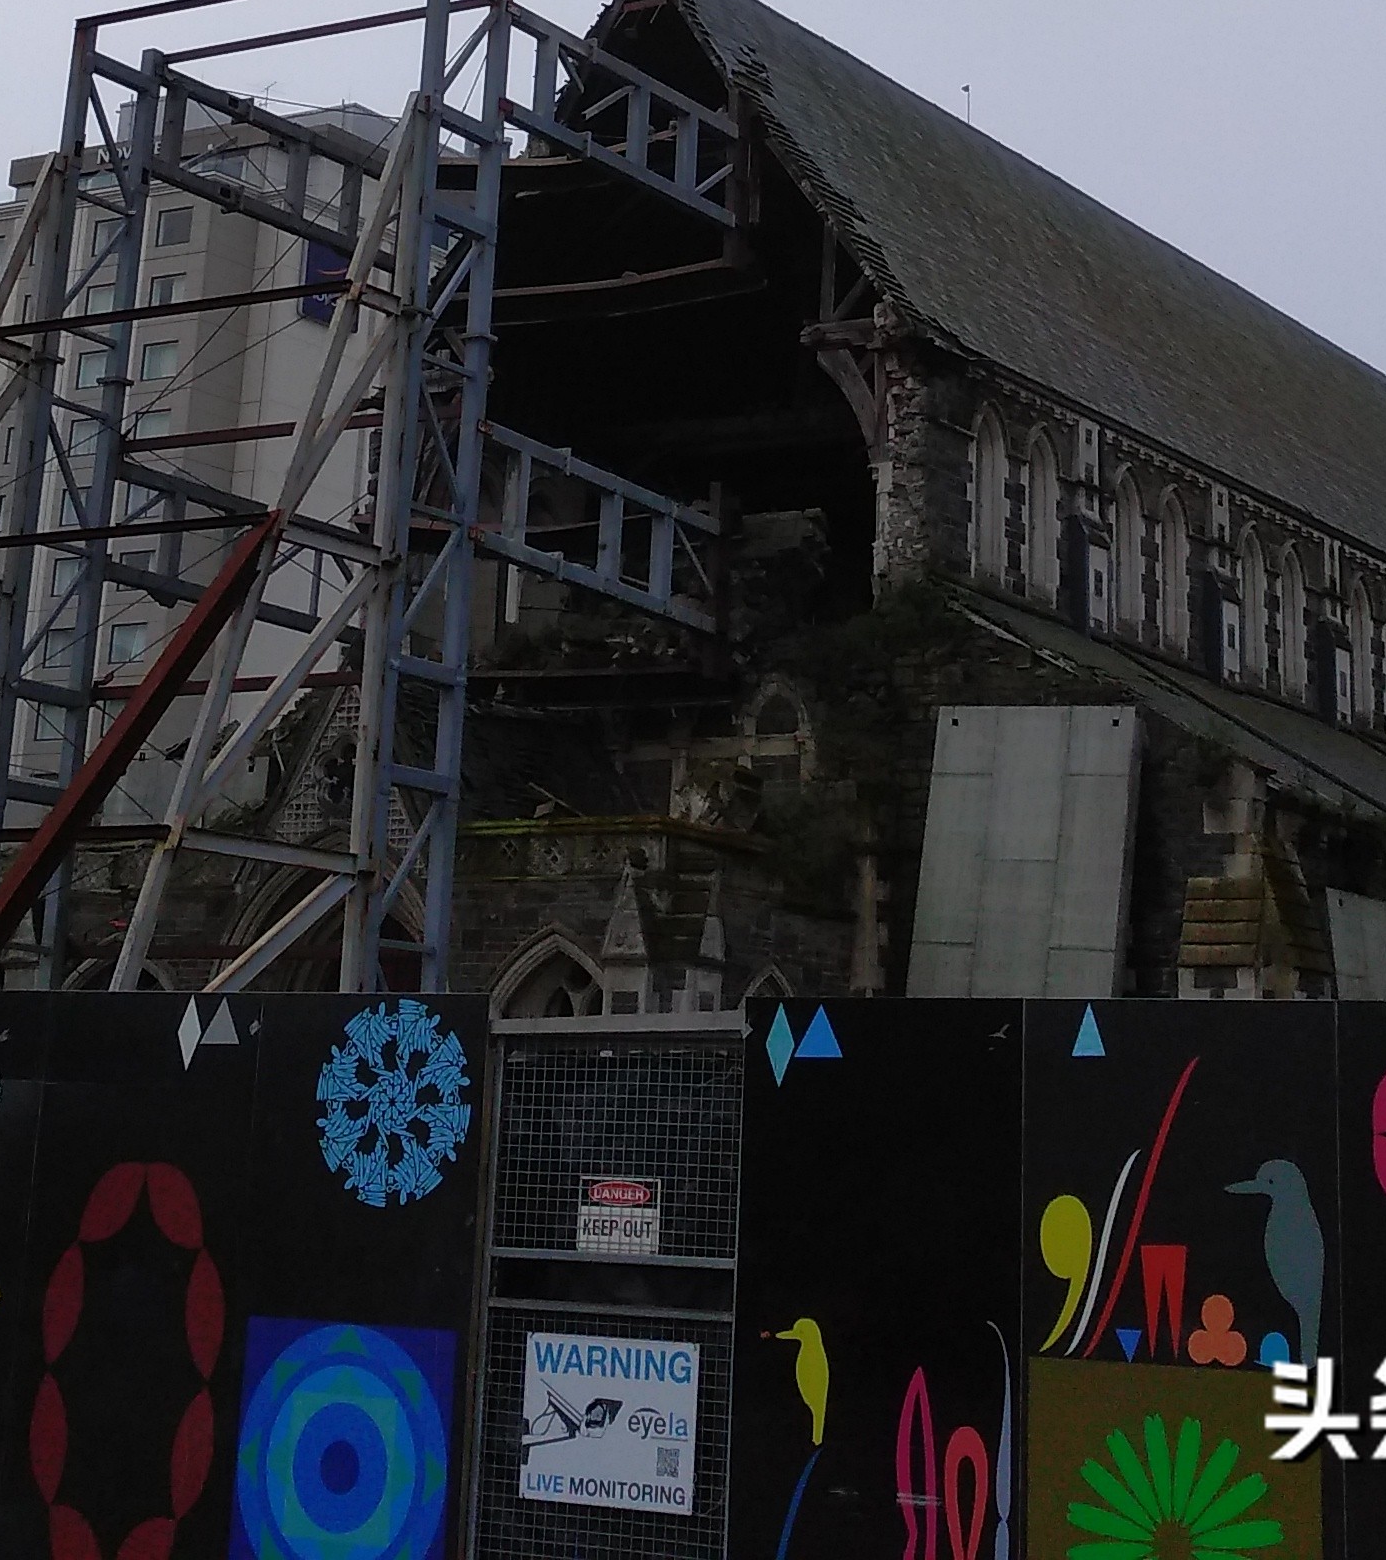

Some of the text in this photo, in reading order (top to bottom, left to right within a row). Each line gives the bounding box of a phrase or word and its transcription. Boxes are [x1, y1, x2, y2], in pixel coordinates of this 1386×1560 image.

[593, 1187, 645, 1201] DANGER
[582, 1217, 653, 1239] KEEP OUT
[534, 1341, 692, 1384] WARNING
[627, 1410, 689, 1439] eyela
[526, 1472, 686, 1507] LIVE MONITORING
